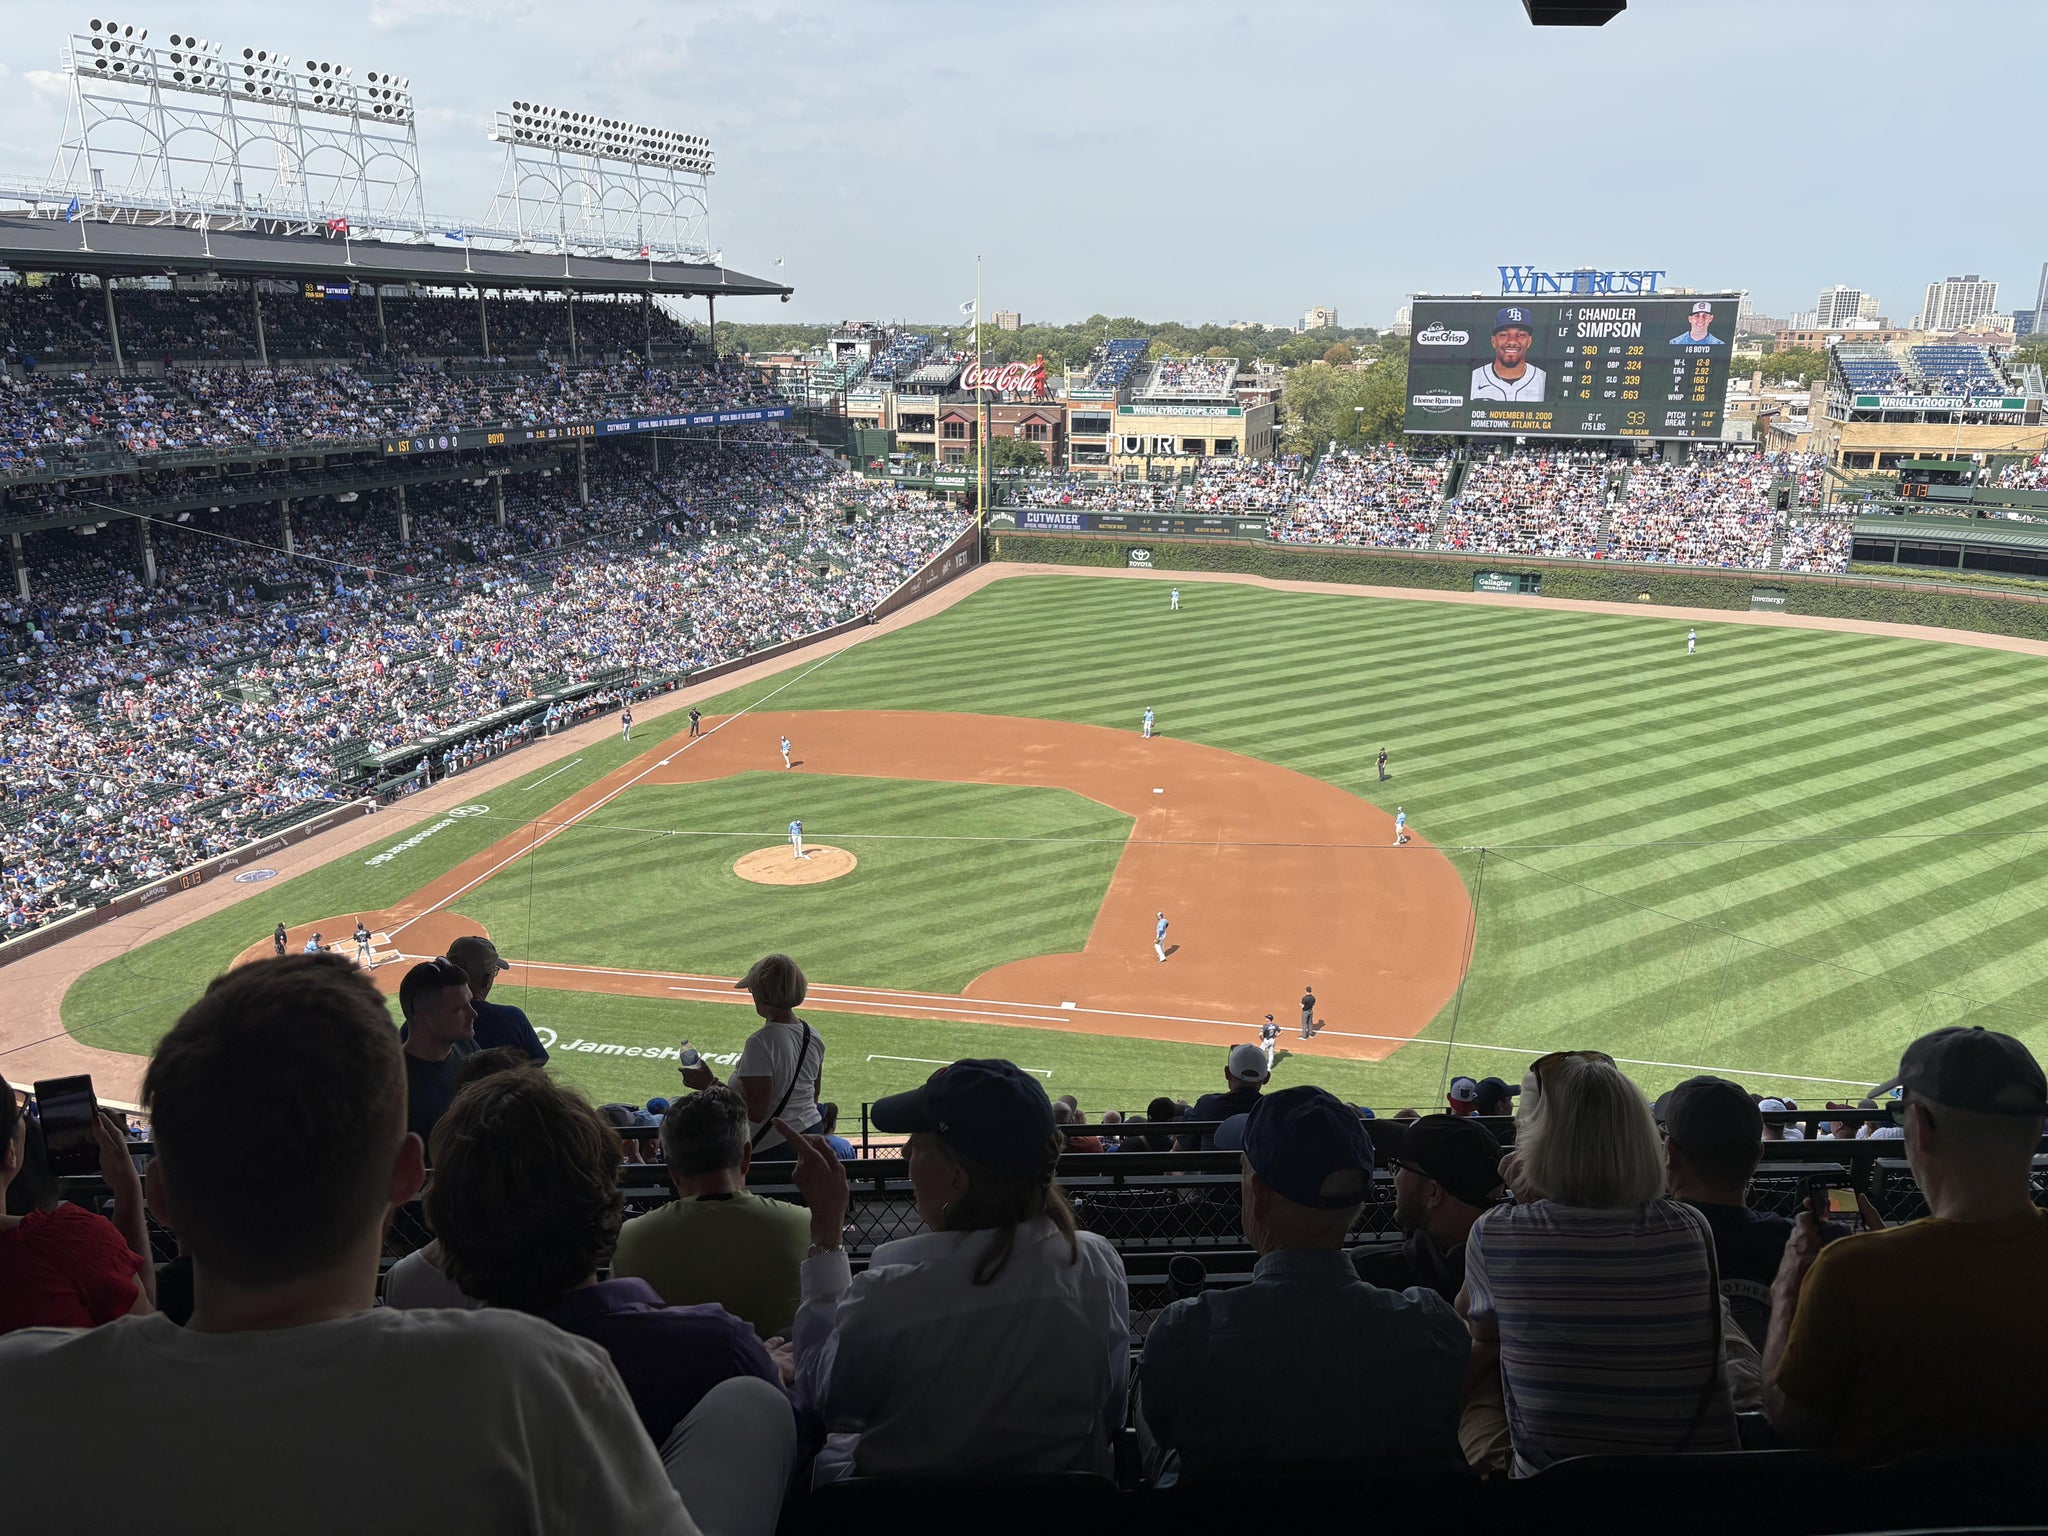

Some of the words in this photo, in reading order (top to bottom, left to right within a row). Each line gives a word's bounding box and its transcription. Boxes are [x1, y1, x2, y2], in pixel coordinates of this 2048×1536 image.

[1497, 266, 1666, 294] WINTRUST
[1578, 308, 1636, 320] CHANDLER
[1558, 327, 1568, 336] LF
[1577, 322, 1641, 338] SIMPSON
[1566, 346, 1574, 354] AB
[1582, 346, 1597, 354] 360
[1625, 346, 1644, 355] .292
[1585, 360, 1591, 369] 0
[1624, 361, 1641, 370] .324
[960, 362, 1045, 394] Coca-Cola
[1581, 375, 1592, 384] 23
[1622, 376, 1640, 385] .339
[1580, 390, 1590, 398] 45
[1604, 390, 1616, 398] OPS
[1620, 390, 1639, 399] .663
[1879, 397, 2003, 409] WRIGLEYROOFTOS.COM
[1132, 406, 1228, 416] WRIGLEYROOFTOPS.COM
[1472, 411, 1486, 419] DOB:
[1489, 411, 1524, 419] NOVEMBER
[1535, 412, 1553, 420] 2000
[1626, 412, 1645, 425] 93
[607, 423, 630, 432] CUTWATER
[1471, 420, 1510, 428] HOMETOWN:
[1511, 421, 1542, 429] ATLANTA,
[1581, 422, 1592, 430] 175
[572, 427, 576, 436] 2
[577, 426, 580, 435] S
[581, 426, 585, 435] 0
[590, 425, 594, 434] 0
[429, 438, 434, 449] 0
[452, 436, 458, 447] 0
[488, 433, 505, 444] BOYD
[991, 513, 1000, 522] JIM
[1001, 512, 1015, 524] BEAM
[1027, 513, 1080, 524] CUTWATER
[955, 550, 968, 568] YETI
[1479, 579, 1512, 587] Gallagher
[1751, 595, 1785, 604] Invenergy
[256, 842, 281, 856] American
[140, 886, 168, 902] MARQUEE
[560, 1039, 743, 1066] JamesHrdi
